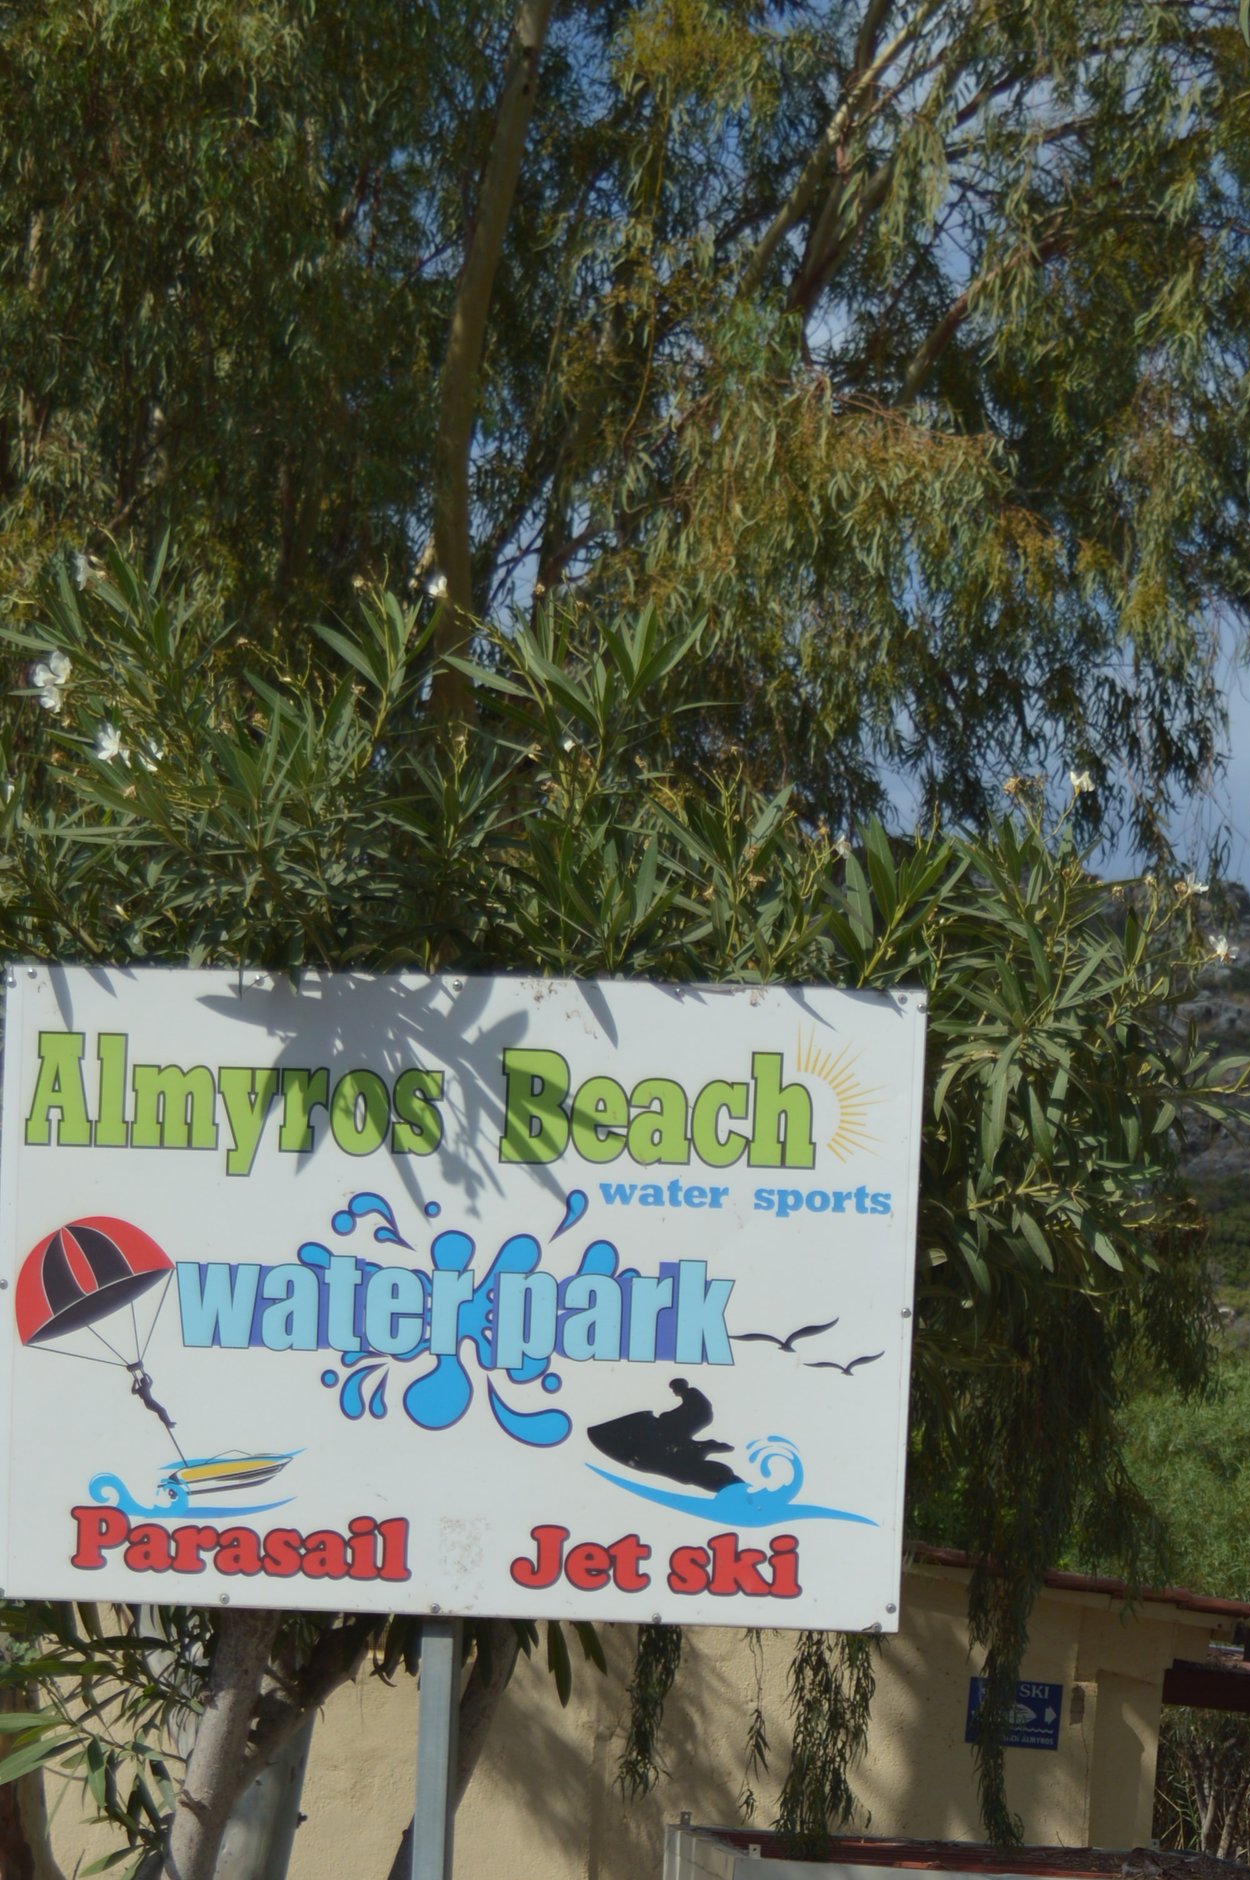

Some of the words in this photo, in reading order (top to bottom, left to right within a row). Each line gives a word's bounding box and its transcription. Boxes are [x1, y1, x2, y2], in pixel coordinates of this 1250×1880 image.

[24, 1031, 445, 1177] Almyros
[499, 1047, 816, 1170] Beach
[599, 1178, 729, 1209] water
[754, 1185, 892, 1218] sports
[175, 1255, 475, 1356] water
[497, 1259, 736, 1370] park
[70, 1505, 412, 1583] Parasail
[510, 1524, 652, 1593] Jet
[667, 1532, 803, 1599] ski
[1018, 1683, 1050, 1699] SKI
